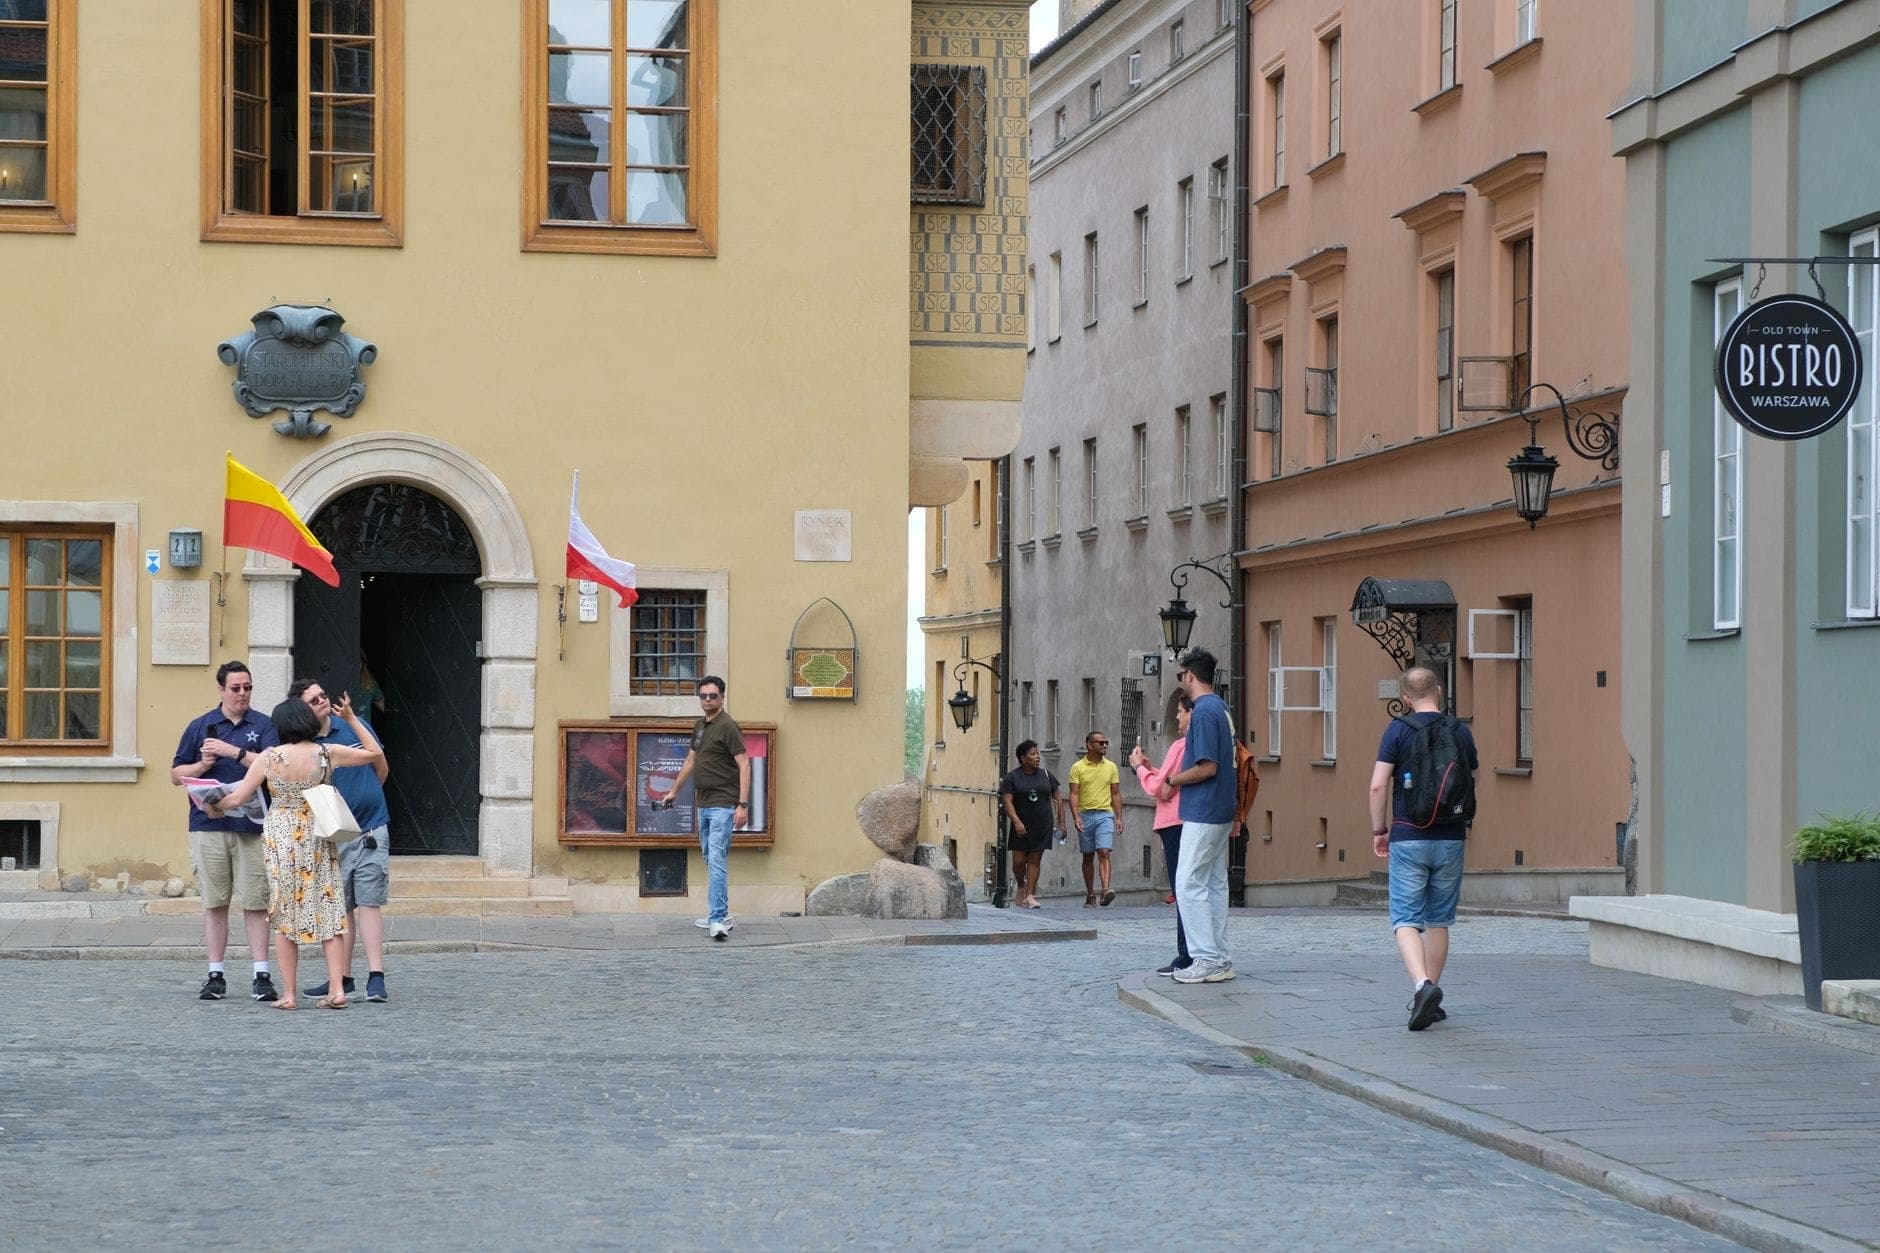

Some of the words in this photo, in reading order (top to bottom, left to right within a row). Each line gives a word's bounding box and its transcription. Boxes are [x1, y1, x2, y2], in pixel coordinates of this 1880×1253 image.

[1762, 326, 1784, 335] OLD
[1787, 326, 1819, 335] TOWN
[253, 351, 345, 368] STAROMIEJSKI
[1740, 343, 1841, 387] BISTRO
[254, 373, 286, 388] DOM
[1751, 395, 1831, 407] WARSZAWA
[801, 515, 845, 528] RYNEK
